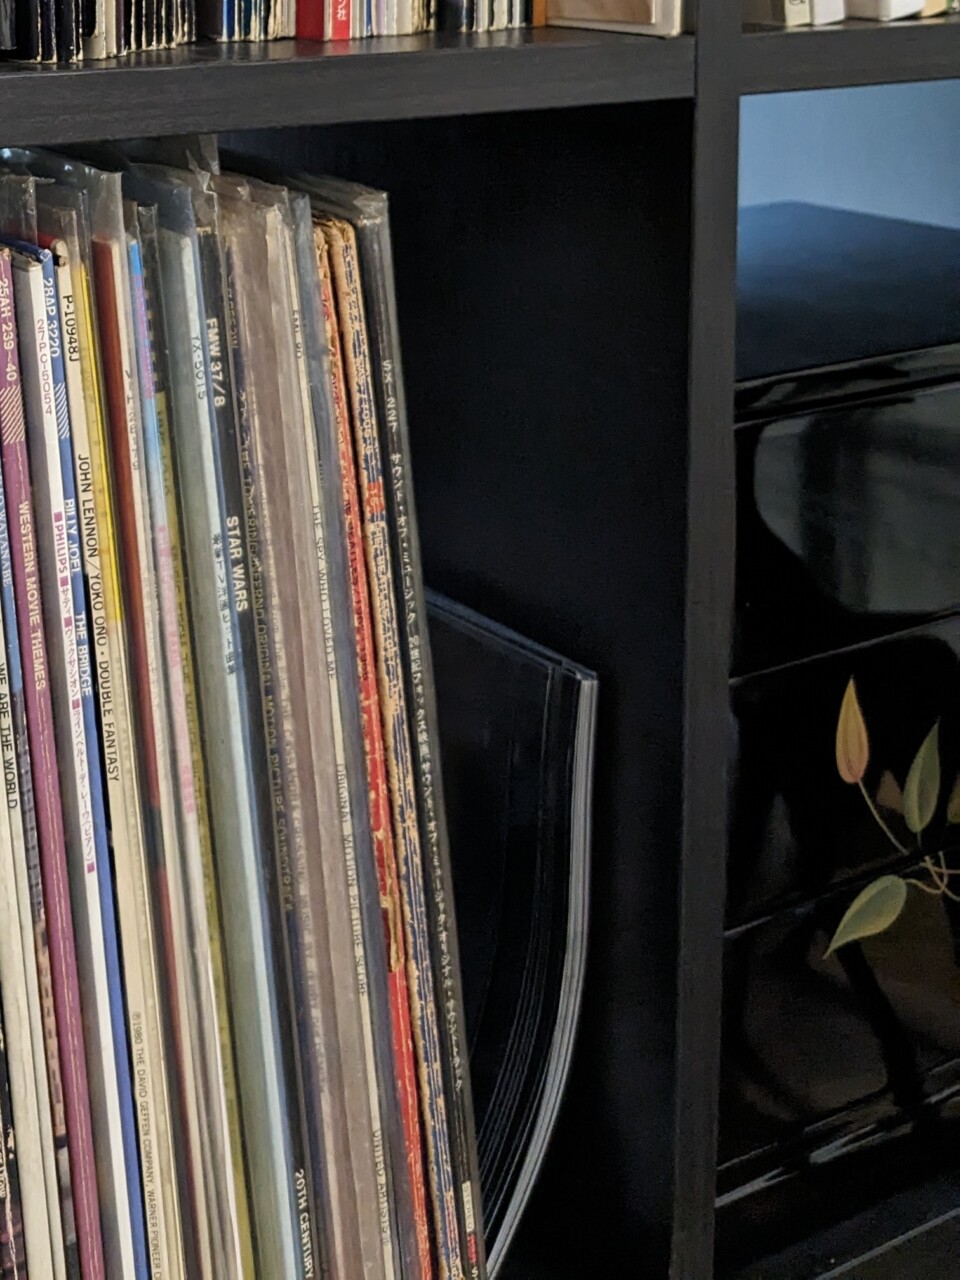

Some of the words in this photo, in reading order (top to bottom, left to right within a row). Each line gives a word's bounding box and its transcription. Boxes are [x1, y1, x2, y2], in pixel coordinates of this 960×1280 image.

[63, 294, 80, 363] P-10948J
[205, 317, 220, 357] FMW
[210, 361, 226, 408] 37/8
[77, 453, 92, 493] JOHN
[17, 501, 35, 572] WESTERN
[64, 498, 79, 534] BILLY
[225, 516, 241, 559] STAR
[54, 523, 68, 574] PHILIPS
[69, 540, 81, 576] JOEL
[25, 577, 42, 626] MOVIE
[231, 562, 248, 612] WARS
[74, 611, 88, 639] THE
[30, 630, 47, 692] THEMES
[78, 644, 93, 697] BRIDGE
[98, 660, 114, 717] DOUBLE
[0, 724, 13, 753] THE
[103, 721, 120, 782] FANTASY
[3, 757, 19, 809] WORLD
[135, 1048, 146, 1067] THE
[138, 1069, 149, 1098] DAVID
[294, 1168, 308, 1210] 20TH
[297, 1212, 314, 1279] CENTURY
